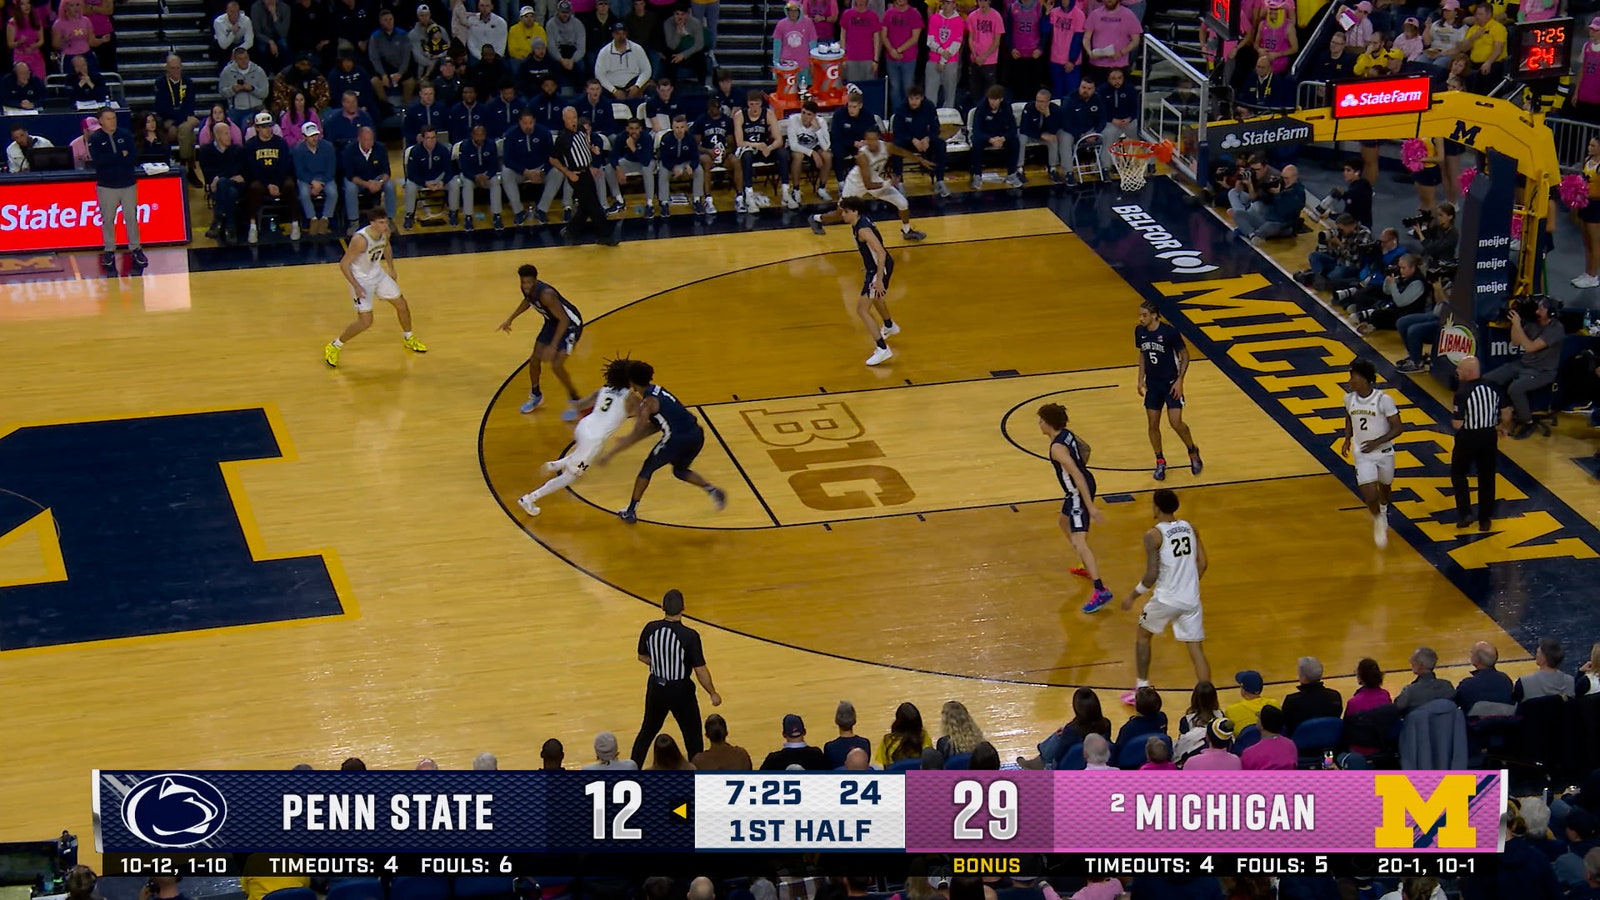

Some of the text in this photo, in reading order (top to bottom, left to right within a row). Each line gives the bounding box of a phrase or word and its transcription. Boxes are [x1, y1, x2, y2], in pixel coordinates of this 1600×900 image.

[1533, 27, 1566, 43] 7:25
[1527, 47, 1555, 70] 24
[826, 65, 839, 79] G
[787, 75, 796, 85] G
[1451, 120, 1482, 145] M
[710, 135, 719, 145] 4
[256, 149, 280, 160] MICHIGAN
[1112, 205, 1183, 250] BELFOR
[1479, 236, 1510, 248] meijer
[1477, 258, 1508, 270] meijer
[1477, 281, 1508, 293] meijer
[1439, 330, 1474, 354] LIBMAN
[1149, 352, 1158, 365] 5
[601, 397, 613, 412] 3
[1351, 409, 1377, 417] MICHIGAN
[1359, 417, 1368, 431] 2
[1171, 536, 1192, 558] 23
